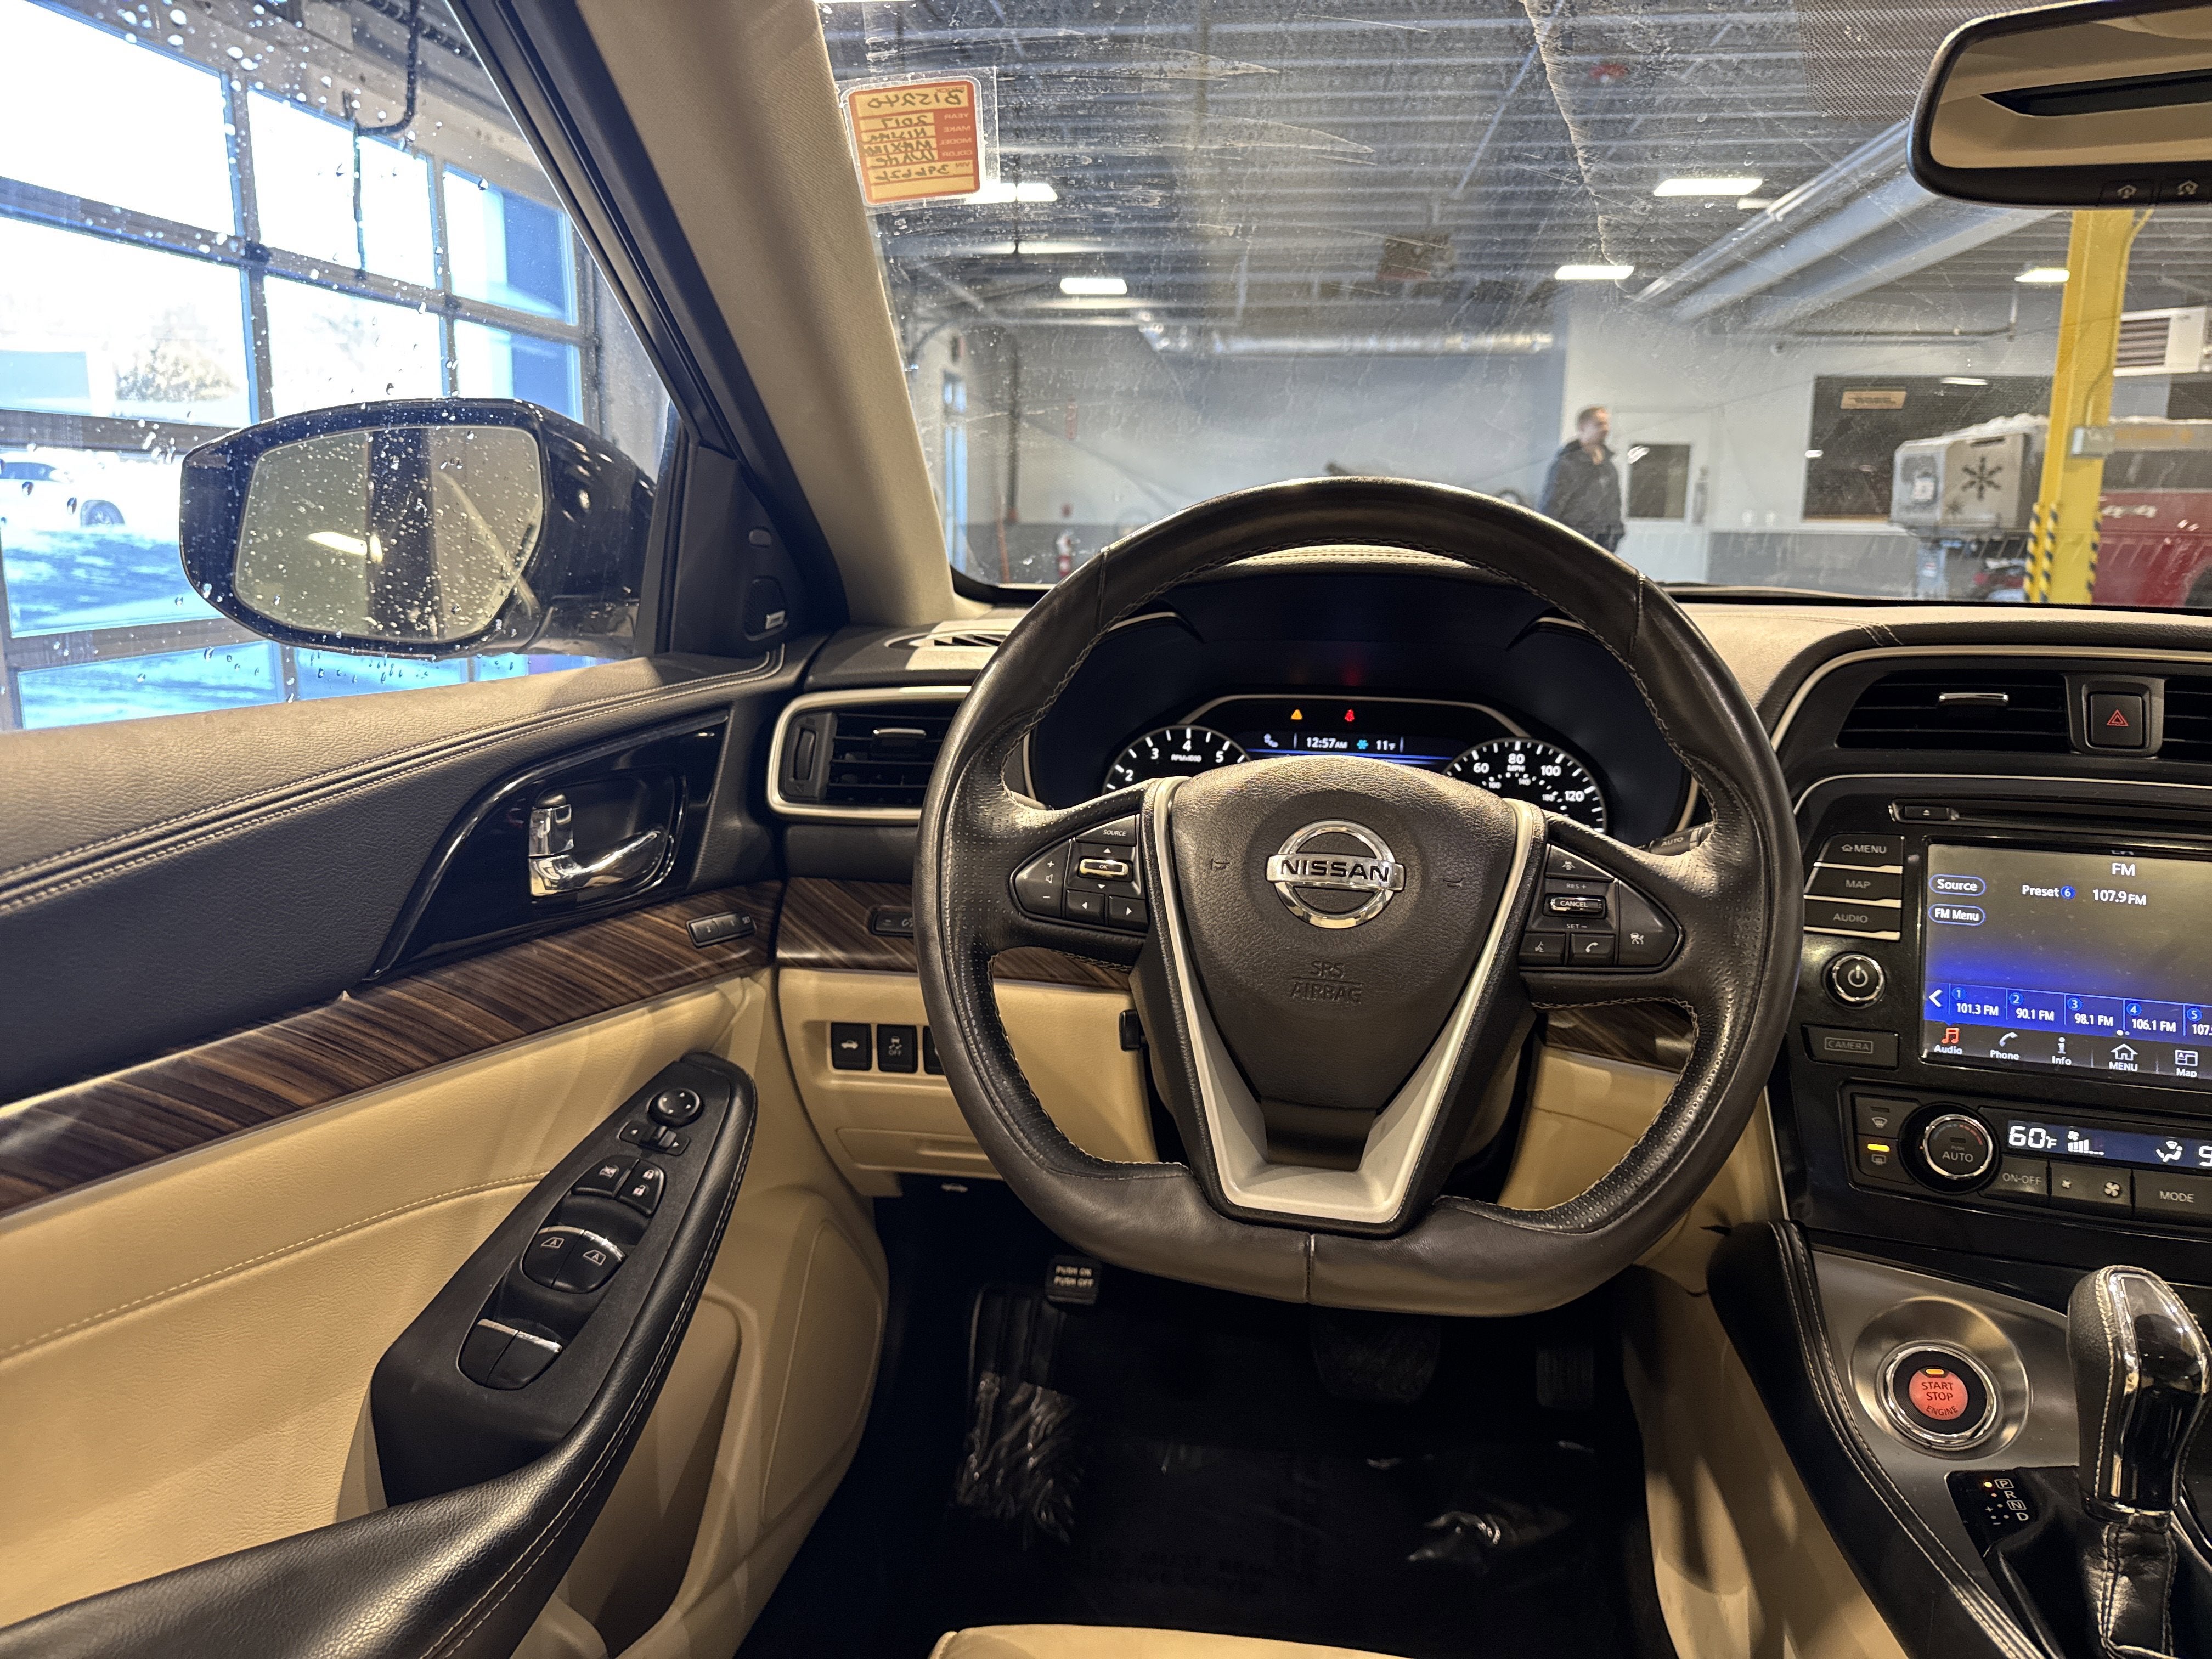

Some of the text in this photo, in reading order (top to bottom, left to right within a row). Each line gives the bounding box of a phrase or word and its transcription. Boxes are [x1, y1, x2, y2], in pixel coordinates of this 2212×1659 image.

[1182, 740, 1191, 751] 4
[1150, 748, 1159, 759] 3
[1215, 751, 1224, 763] 5
[1508, 753, 1525, 764] 80
[1473, 762, 1489, 774] 60
[1541, 765, 1561, 776] 100
[1125, 769, 1133, 781] 2
[1565, 790, 1585, 802] 120
[1661, 837, 1684, 847] AUTO
[1853, 844, 1887, 854] MENU
[1281, 860, 1389, 882] NISSAN
[2112, 862, 2135, 876] FM
[1846, 879, 1871, 889] MAP
[1937, 879, 1978, 891] Source
[2022, 884, 2060, 897] Preset
[2064, 888, 2072, 897] 6
[1833, 913, 1868, 923] AUDIO
[1934, 908, 1979, 921] FM Menu
[1311, 961, 1344, 979] SRS
[1290, 983, 1362, 1003] AIRBAG
[2013, 995, 2019, 1003] 2
[2071, 999, 2078, 1009] 3
[1956, 1002, 1999, 1016] 101.3 FM
[2016, 1008, 2055, 1021] 90.1 FM
[2130, 1005, 2137, 1014] 4
[2074, 1013, 2114, 1026] 98.1 FM
[2191, 1011, 2198, 1020] 5
[2132, 1018, 2176, 1032] 106.1 FM
[2192, 1024, 2212, 1036] 107.
[1827, 1040, 1870, 1051] CAMERA
[1934, 1044, 1963, 1056] Audio
[1990, 1049, 2019, 1060] Phone
[2052, 1056, 2072, 1066] Info
[2109, 1061, 2138, 1072] MENU
[2176, 1068, 2198, 1078] Map
[1942, 1151, 1974, 1163] AUTO
[2002, 1173, 2042, 1186] ON-OFF
[2159, 1190, 2194, 1203] MODE
[1921, 1381, 1954, 1390] START
[1926, 1392, 1954, 1401] STOP
[1926, 1404, 1958, 1416] ENGINE
[2004, 1491, 2018, 1499] R
[2016, 1512, 2029, 1521] D
